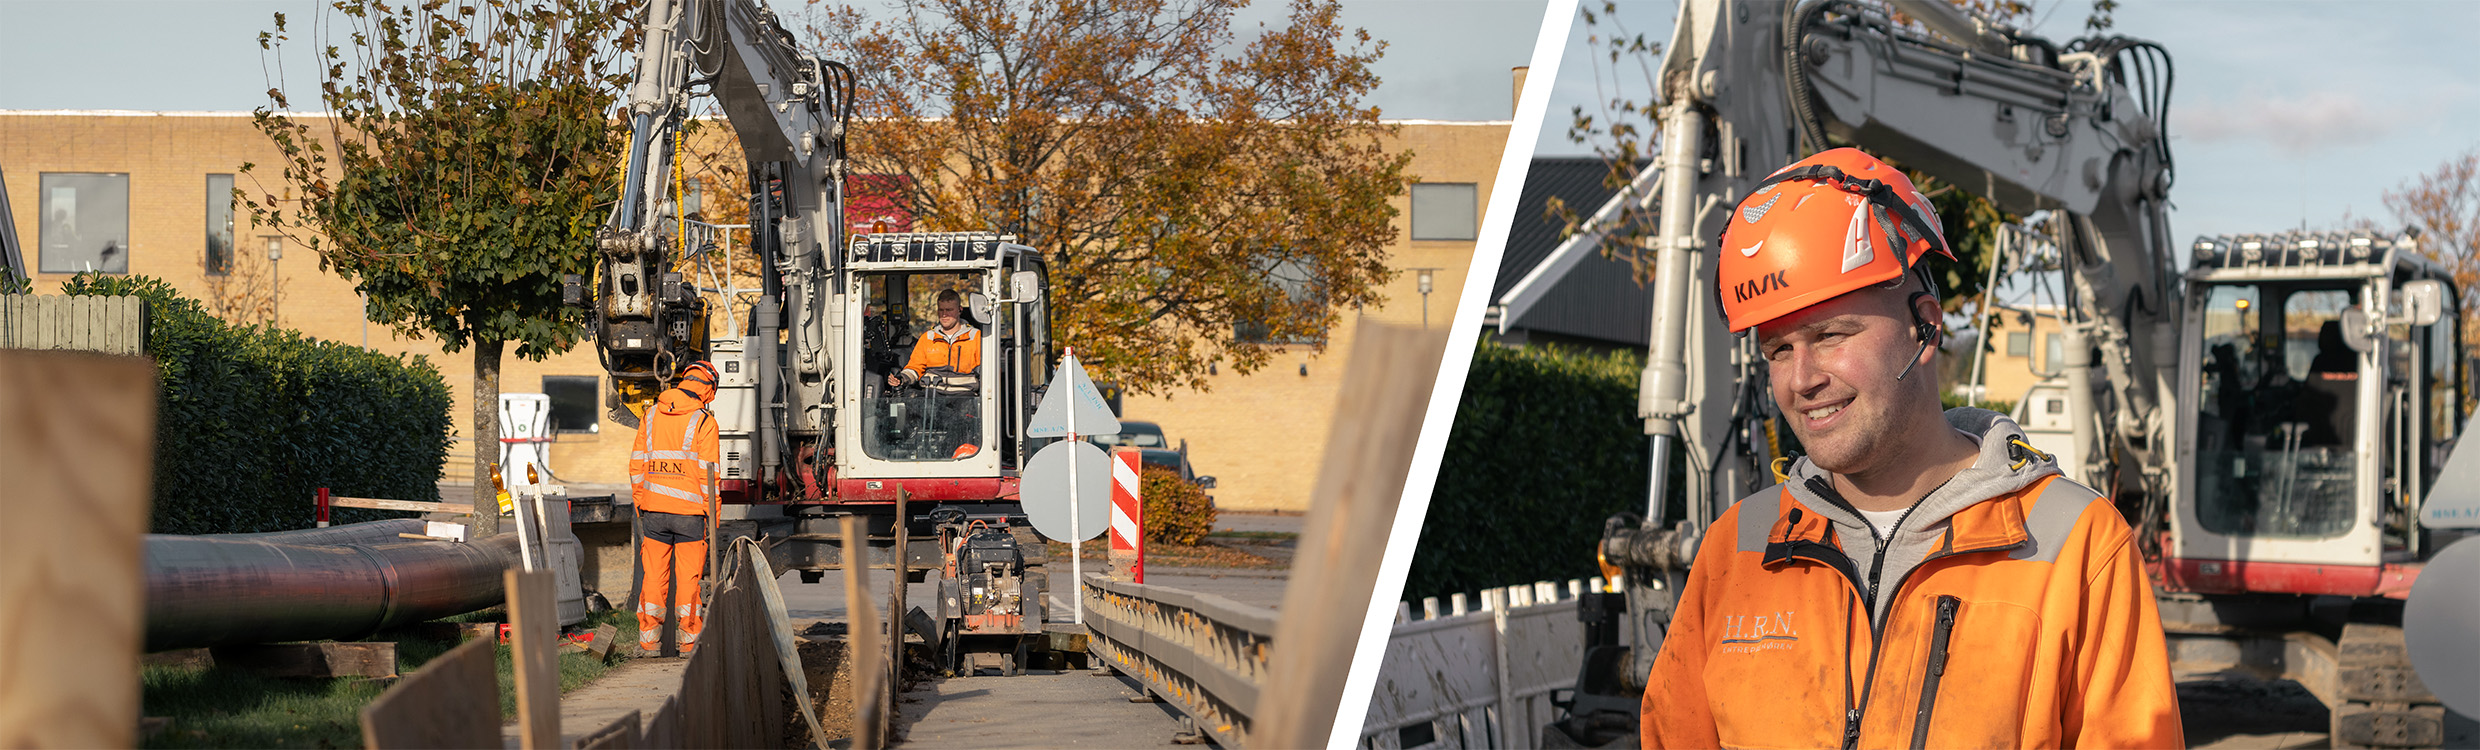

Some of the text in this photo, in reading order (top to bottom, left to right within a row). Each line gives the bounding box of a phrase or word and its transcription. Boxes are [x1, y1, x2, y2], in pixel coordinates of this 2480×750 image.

[1735, 269, 1789, 303] KASK
[648, 461, 686, 474] H.R.N.
[1723, 611, 1797, 638] H.R.N.
